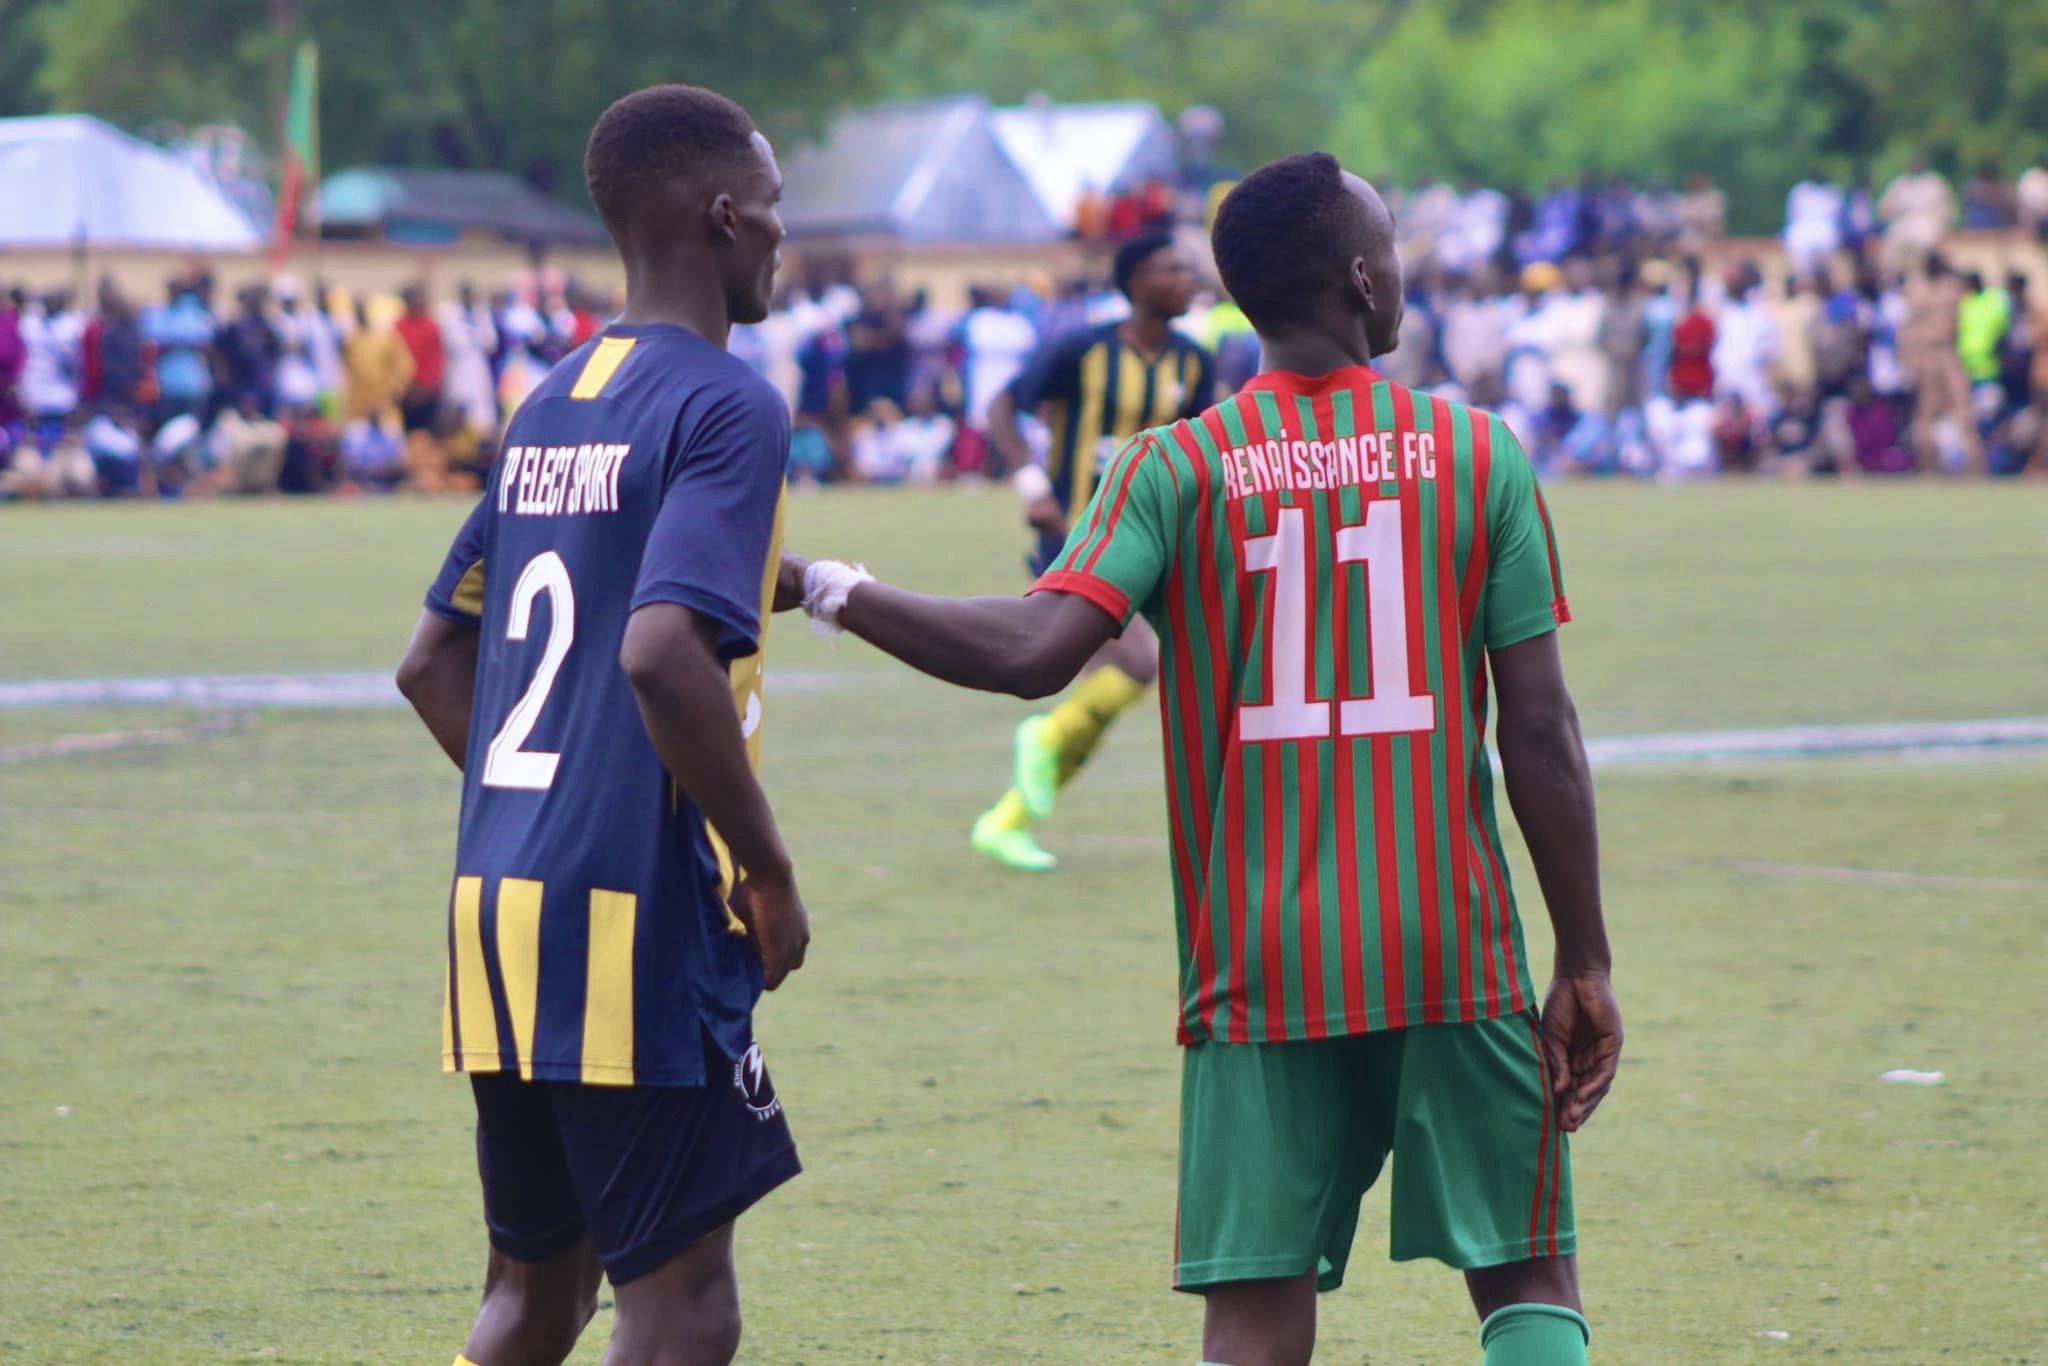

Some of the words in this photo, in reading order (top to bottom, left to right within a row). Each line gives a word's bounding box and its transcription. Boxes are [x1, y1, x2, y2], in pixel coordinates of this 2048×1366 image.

[516, 446, 577, 516] ELECT
[567, 443, 631, 515] SPORT
[1403, 431, 1436, 480] FC
[482, 550, 574, 790] 2
[1239, 499, 1435, 741] 11
